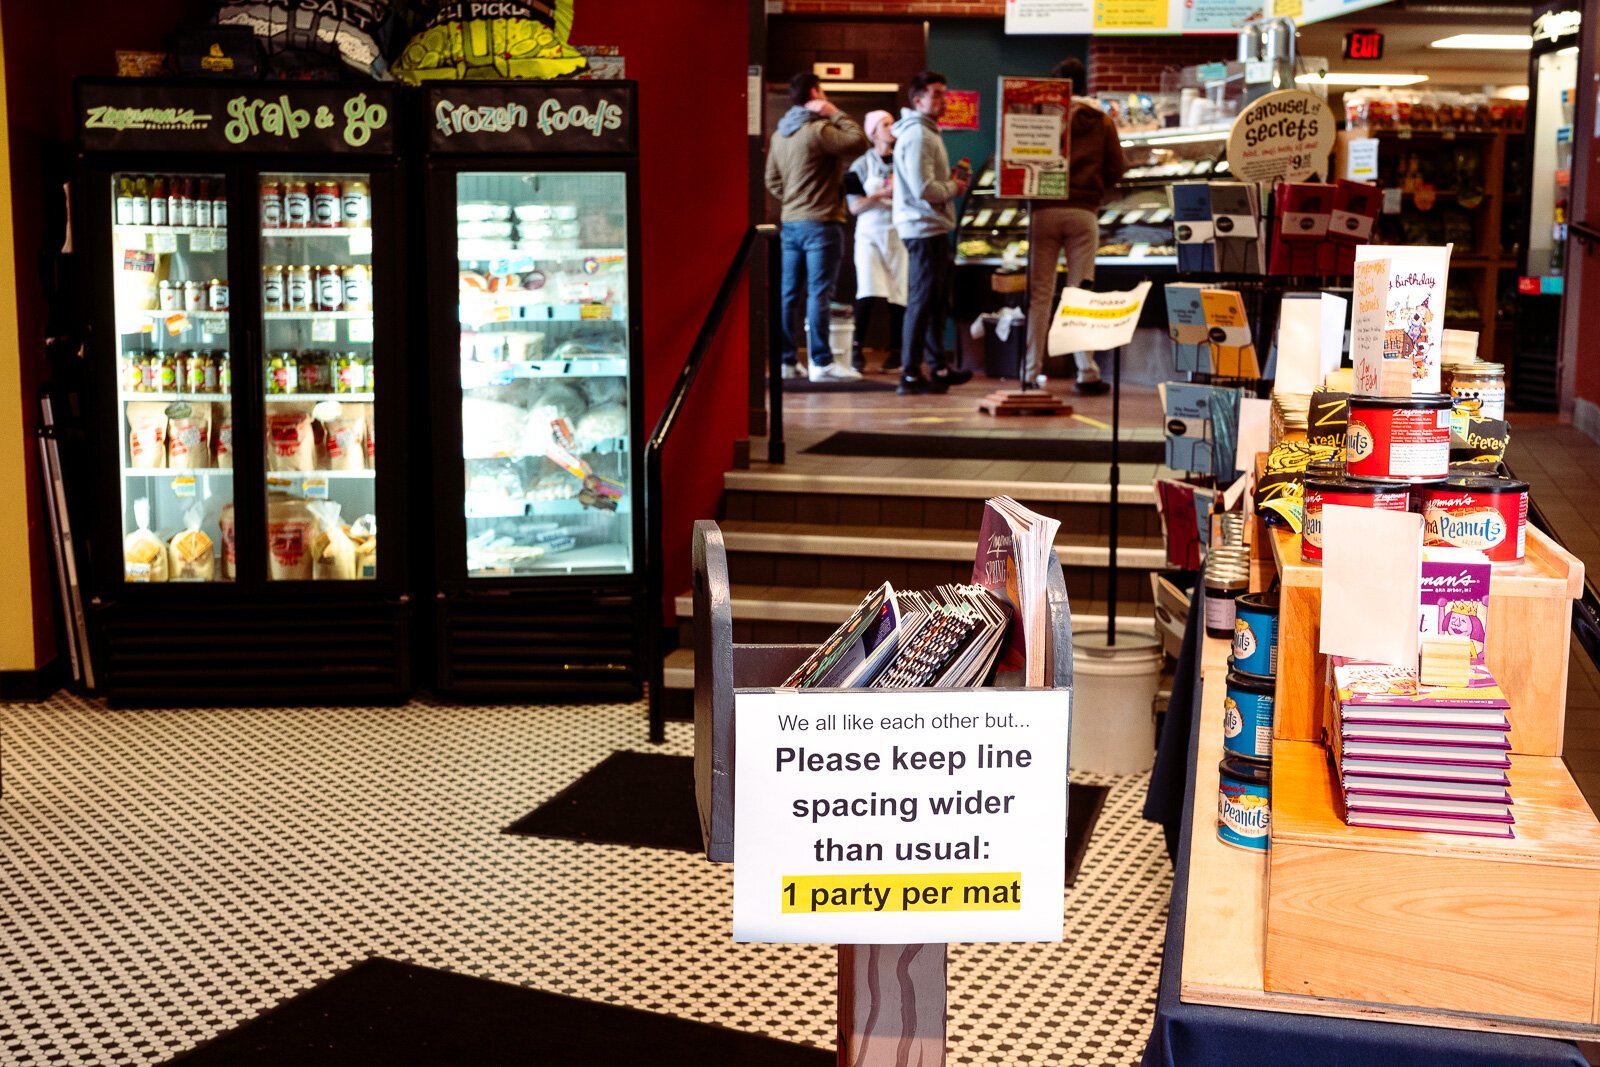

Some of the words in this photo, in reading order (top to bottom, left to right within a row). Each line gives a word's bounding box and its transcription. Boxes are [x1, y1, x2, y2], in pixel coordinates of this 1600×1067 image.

[1351, 34, 1380, 59] EXIT
[224, 95, 311, 144] grab
[314, 105, 334, 129] &
[343, 92, 388, 147] go
[435, 99, 529, 137] frozen
[536, 98, 623, 137] foods
[1245, 116, 1319, 147] secrets
[1395, 272, 1436, 289] birthday
[1439, 515, 1501, 542] Peanuts
[778, 714, 809, 731] We
[815, 714, 836, 731] all
[843, 714, 874, 730] like
[880, 713, 925, 730] each
[931, 713, 980, 729] other
[985, 712, 1030, 728] but...
[776, 747, 881, 772] Please
[892, 745, 966, 776] keep
[978, 743, 1032, 769] line
[792, 791, 918, 824] spacing
[928, 789, 1016, 815] wider
[813, 837, 883, 862] than
[895, 835, 990, 861] usual:
[783, 882, 796, 906] 1
[811, 882, 892, 912] party
[902, 886, 954, 911] per
[963, 880, 1021, 904] mat
